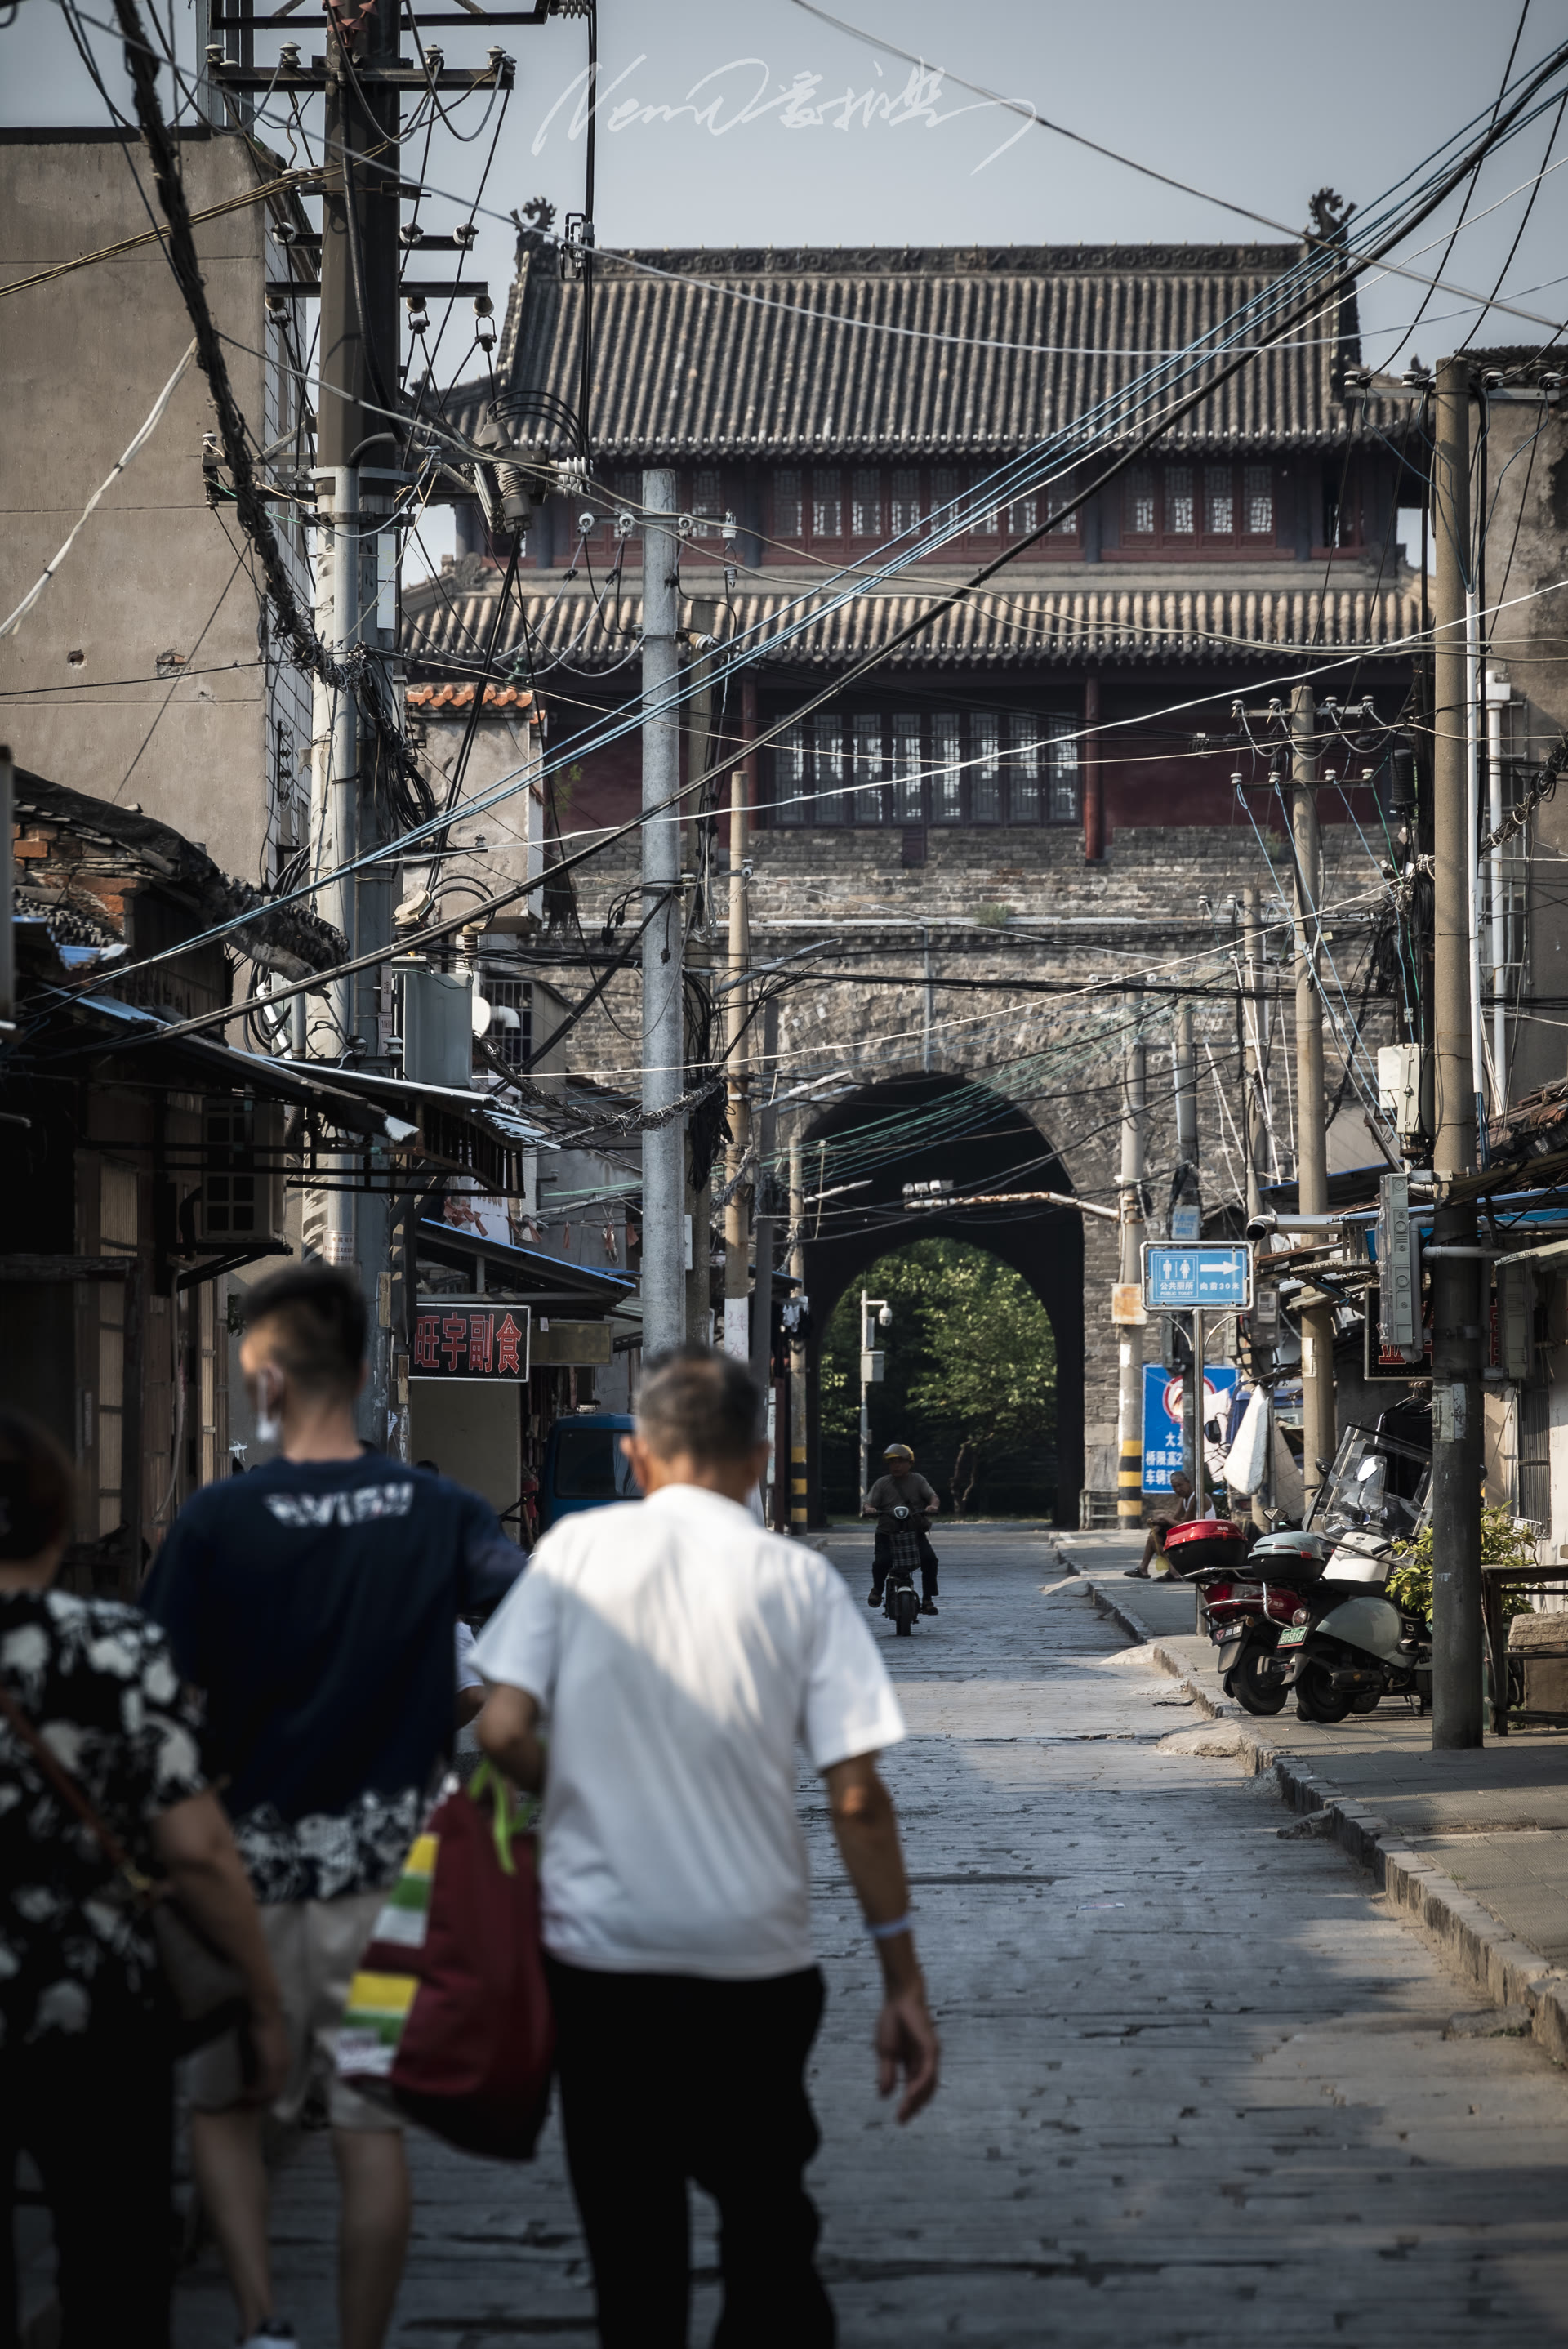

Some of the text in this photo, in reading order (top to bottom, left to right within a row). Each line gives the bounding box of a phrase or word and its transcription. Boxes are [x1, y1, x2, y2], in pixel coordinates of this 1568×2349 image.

[1160, 1281, 1194, 1290] 公共厕所
[1200, 1281, 1240, 1290] 向前30米
